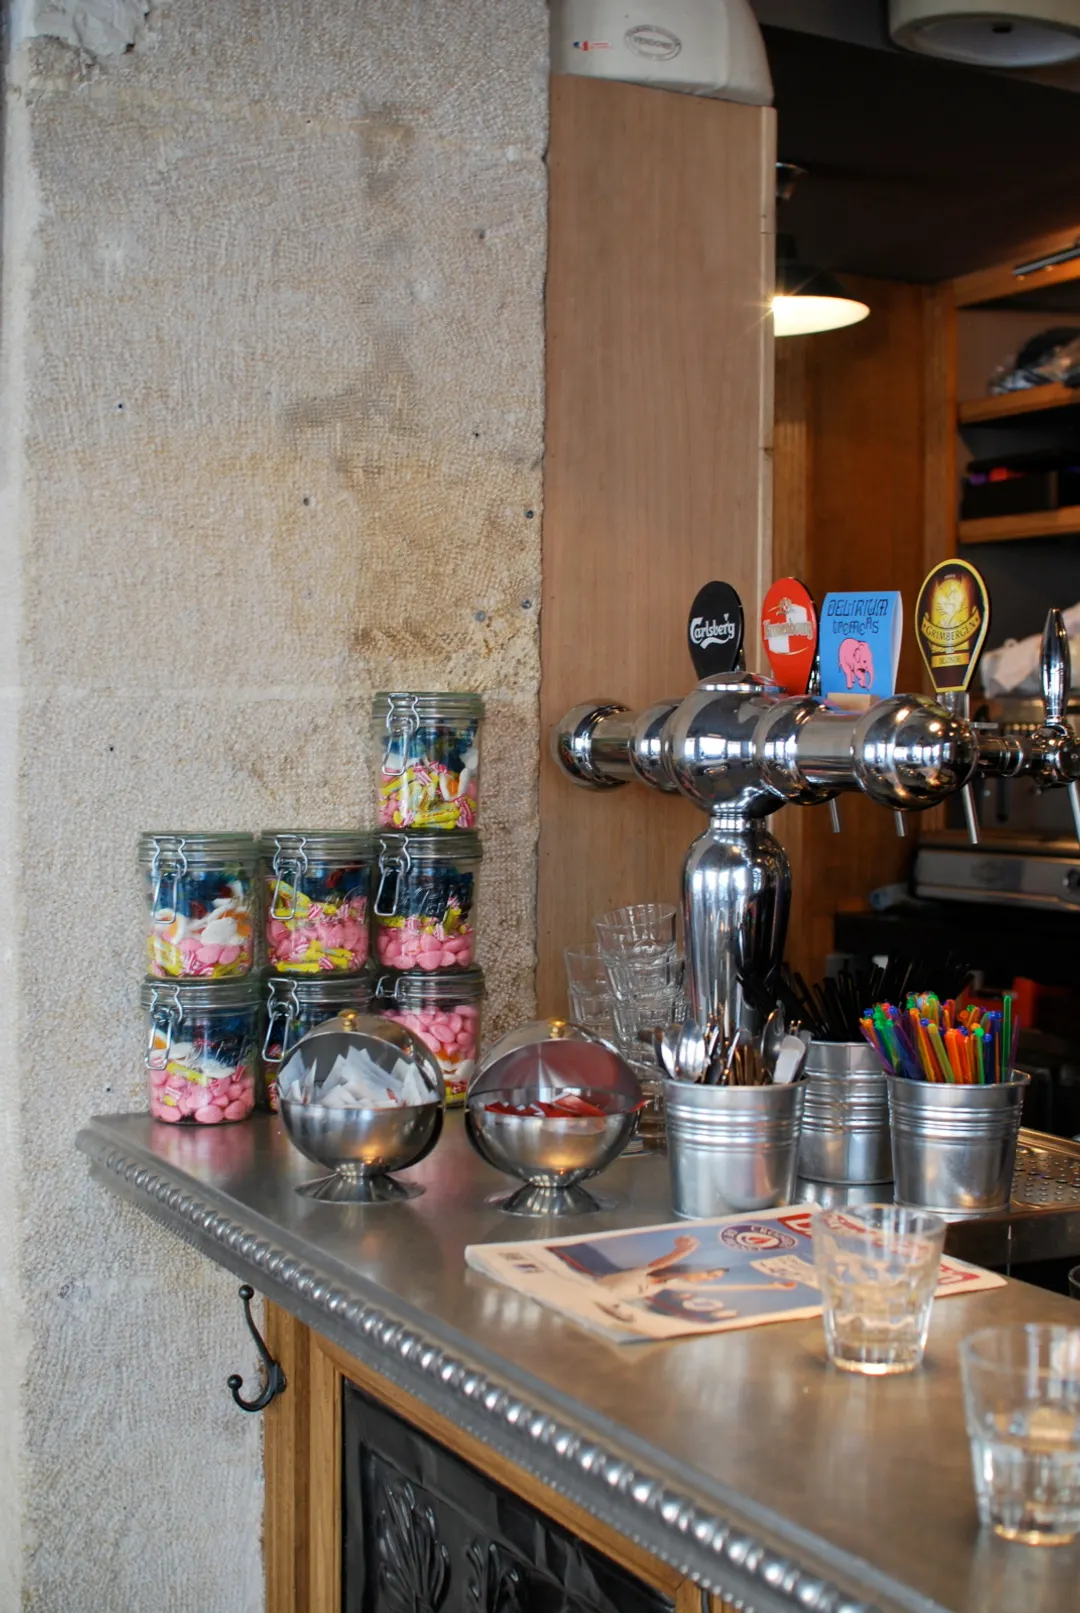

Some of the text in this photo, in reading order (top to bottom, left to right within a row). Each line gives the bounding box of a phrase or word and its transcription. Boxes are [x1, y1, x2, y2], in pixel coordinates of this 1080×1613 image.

[827, 599, 888, 616] DELIRIUM
[690, 613, 735, 646] Carlsberg
[925, 619, 978, 641] GRIMBERGEN
